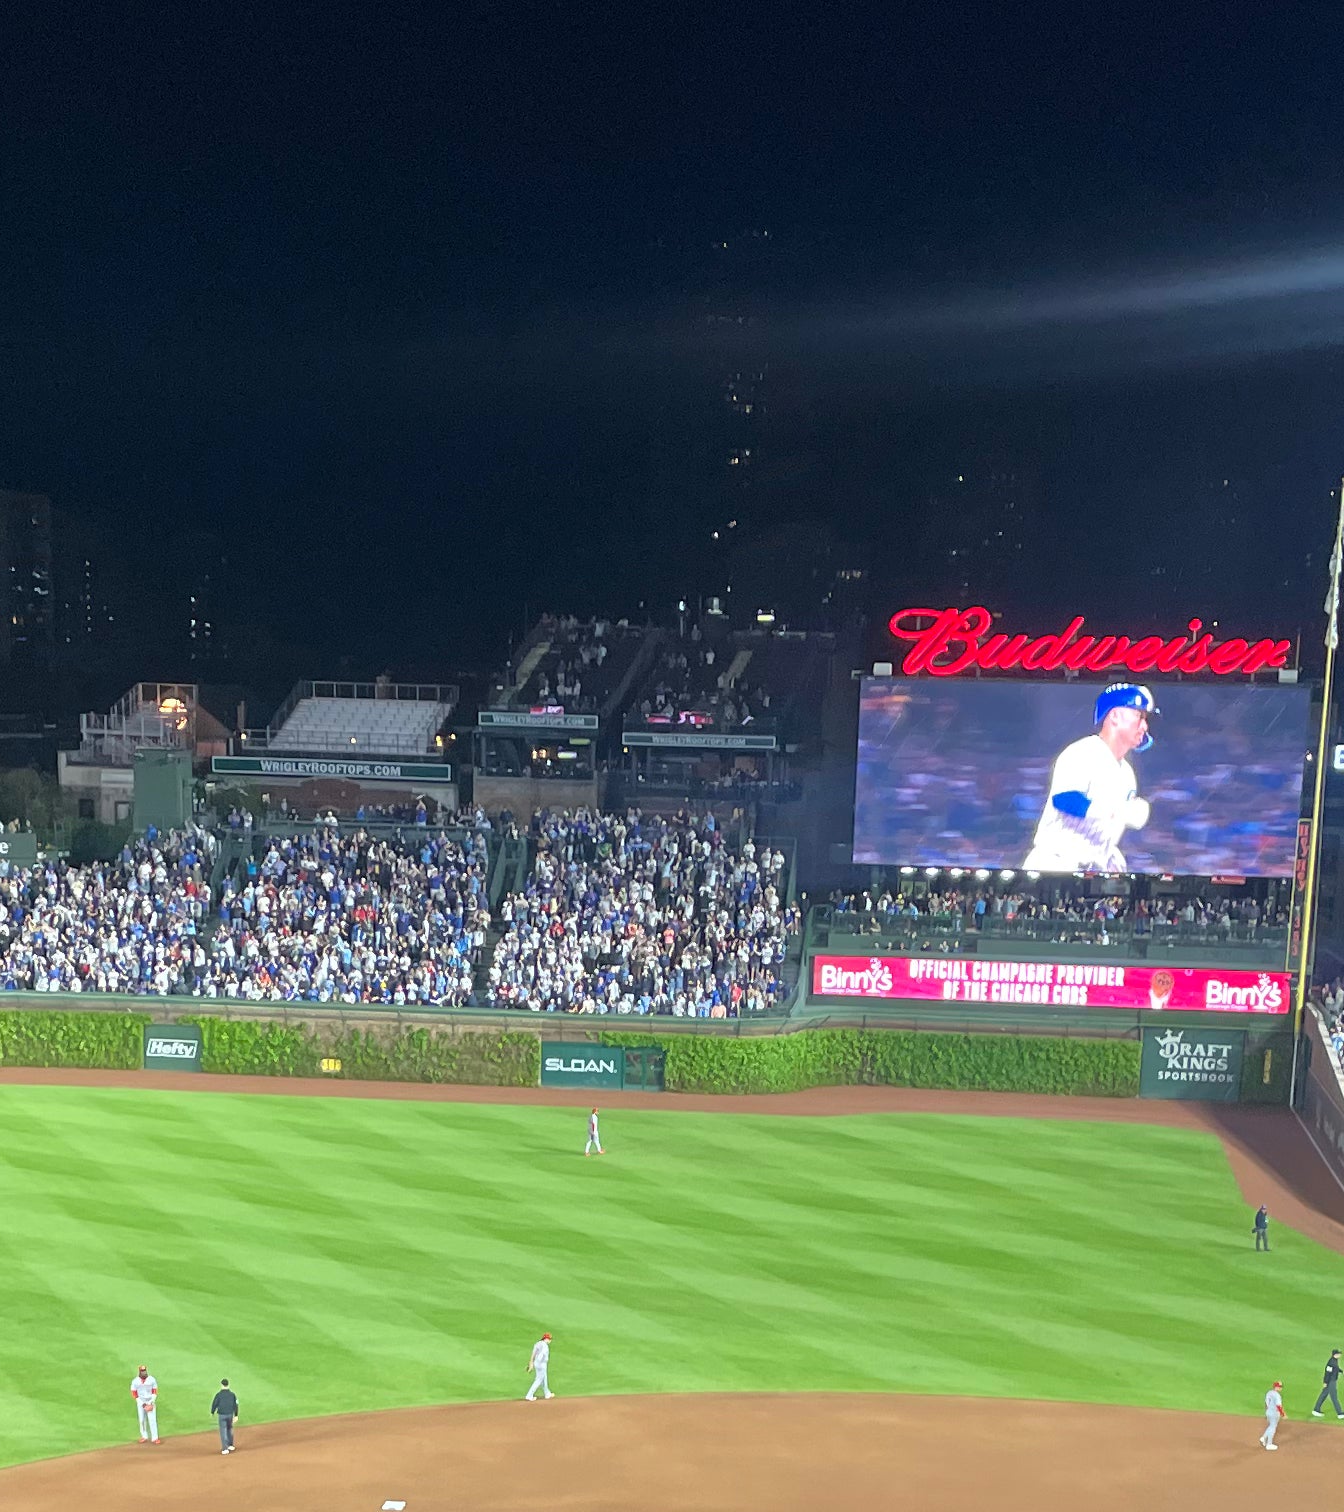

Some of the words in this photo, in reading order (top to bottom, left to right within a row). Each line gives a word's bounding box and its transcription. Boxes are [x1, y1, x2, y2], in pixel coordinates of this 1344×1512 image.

[889, 606, 1291, 676] Budweiser
[260, 760, 402, 778] WRIGLEYROOFTOPS.COM
[821, 964, 892, 993] Binny's
[909, 959, 968, 980] OFFICIAL
[972, 961, 1052, 984] CHAMPAGNE
[1056, 964, 1124, 986] PROVIDER
[1205, 978, 1282, 1009] Binny's
[943, 980, 960, 1000] OF
[963, 982, 988, 1001] THE
[992, 983, 1050, 1004] CHICAGO
[1054, 985, 1088, 1006] CUBS
[150, 1040, 194, 1056] Hefty
[1163, 1039, 1232, 1058] DRAFT
[545, 1058, 614, 1074] SLOAN
[1168, 1055, 1228, 1071] KINGS
[1157, 1070, 1234, 1083] SPORTSBOOK
